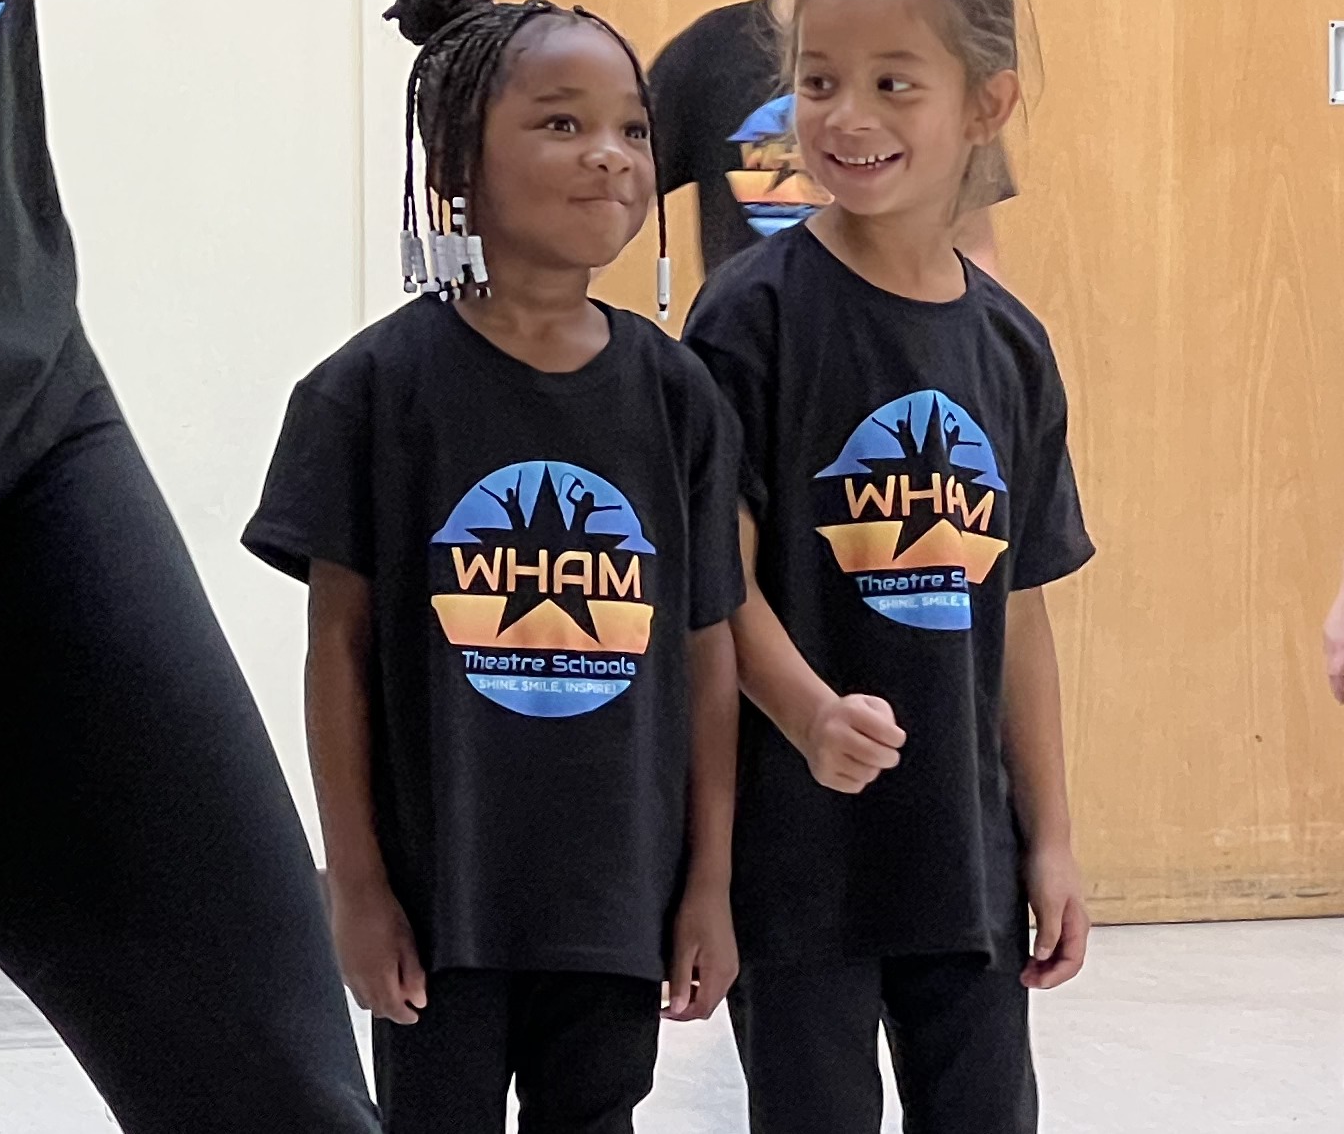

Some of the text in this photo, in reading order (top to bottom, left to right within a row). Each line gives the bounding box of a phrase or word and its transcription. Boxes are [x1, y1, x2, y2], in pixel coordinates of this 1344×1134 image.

[844, 473, 995, 531] WHAM
[451, 547, 641, 598] WHAM
[856, 573, 945, 594] Theatre
[462, 651, 636, 676] Theatre Schools
